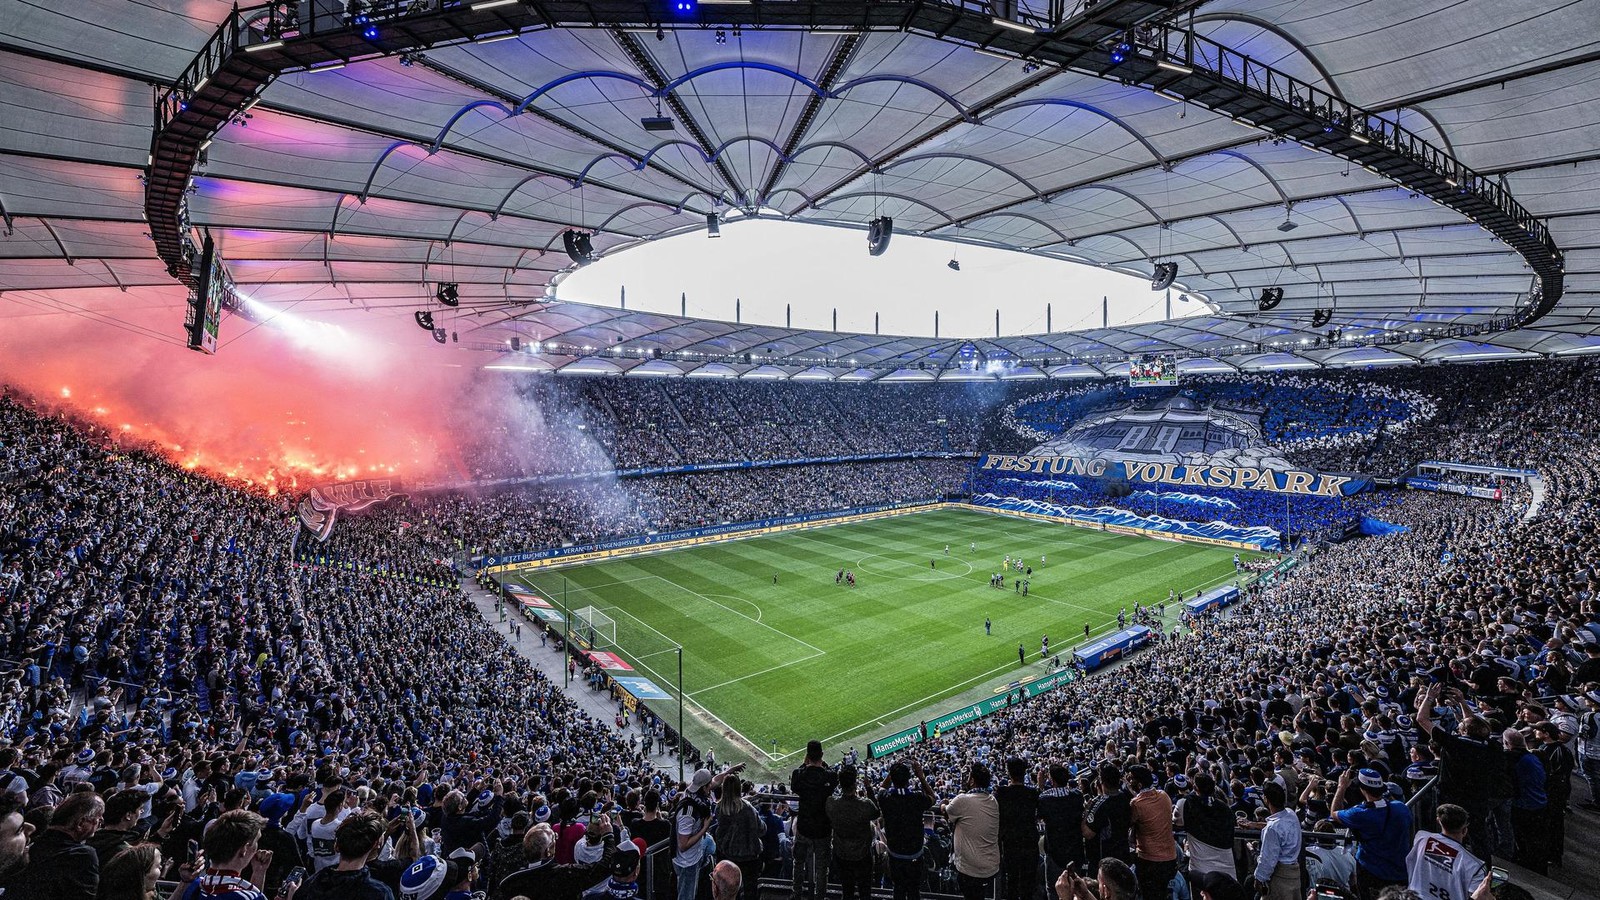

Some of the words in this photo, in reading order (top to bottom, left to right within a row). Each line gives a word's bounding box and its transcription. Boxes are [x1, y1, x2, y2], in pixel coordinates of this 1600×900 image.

[982, 454, 1106, 476] FESTUNG
[1122, 460, 1350, 497] VOLKSPARK
[323, 480, 393, 505] WIR
[522, 551, 549, 560] BUCHEN!
[1037, 674, 1068, 691] HanseMrkur
[936, 710, 974, 729] HanseMerkur
[1429, 882, 1450, 900] 28
